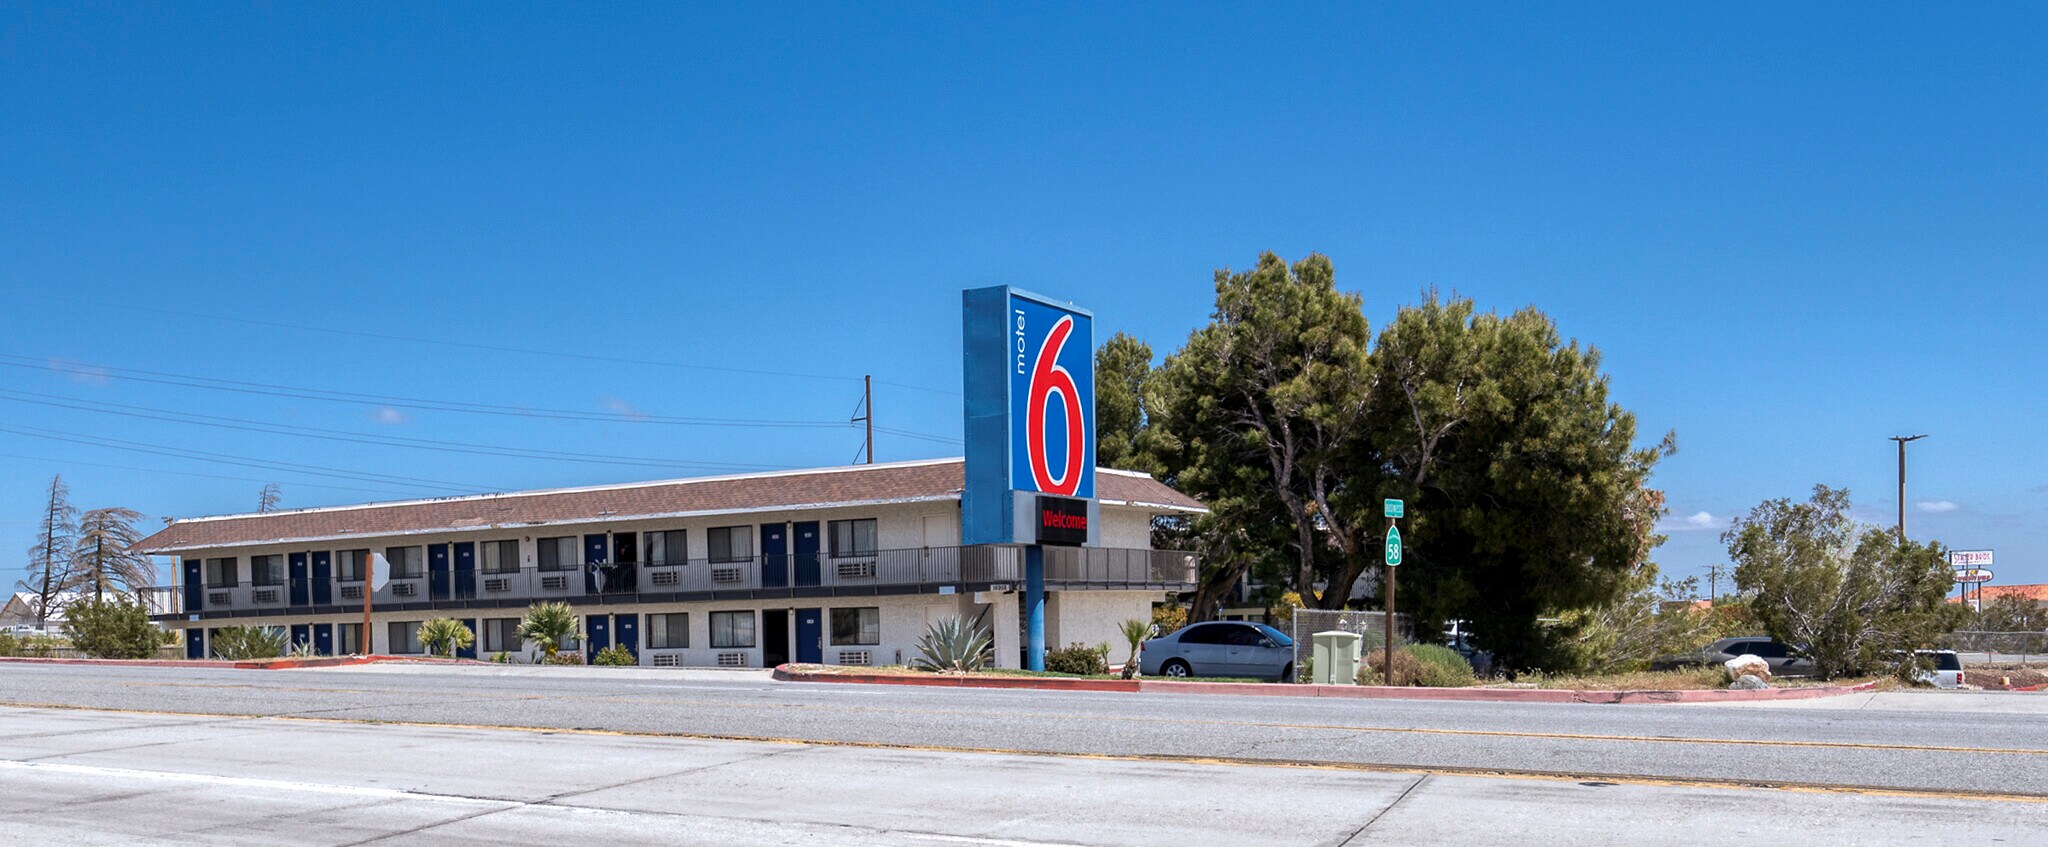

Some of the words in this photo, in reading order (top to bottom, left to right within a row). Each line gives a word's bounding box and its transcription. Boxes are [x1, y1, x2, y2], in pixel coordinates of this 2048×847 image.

[1015, 309, 1026, 375] motel
[1026, 314, 1086, 497] 6
[1042, 509, 1087, 530] Welcome
[1388, 543, 1399, 560] 58
